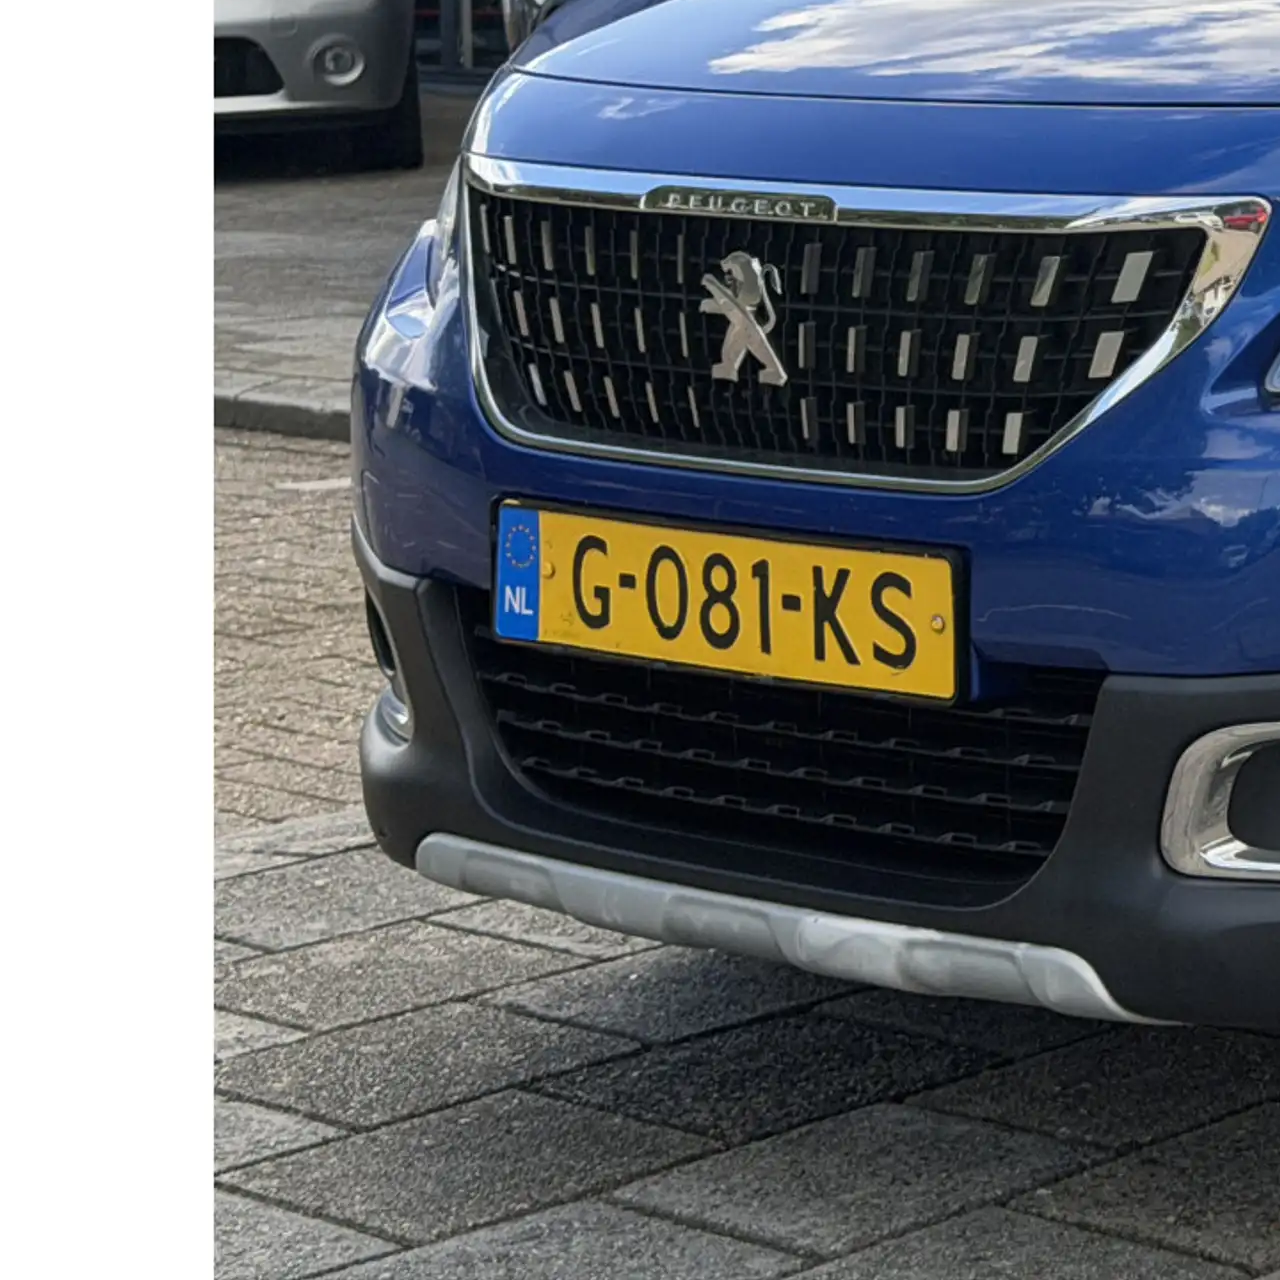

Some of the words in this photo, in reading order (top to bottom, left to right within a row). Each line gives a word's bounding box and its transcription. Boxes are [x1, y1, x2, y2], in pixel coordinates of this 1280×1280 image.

[667, 192, 817, 218] PEUGEOT
[504, 584, 534, 616] NL
[571, 535, 917, 670] G-081-KS
